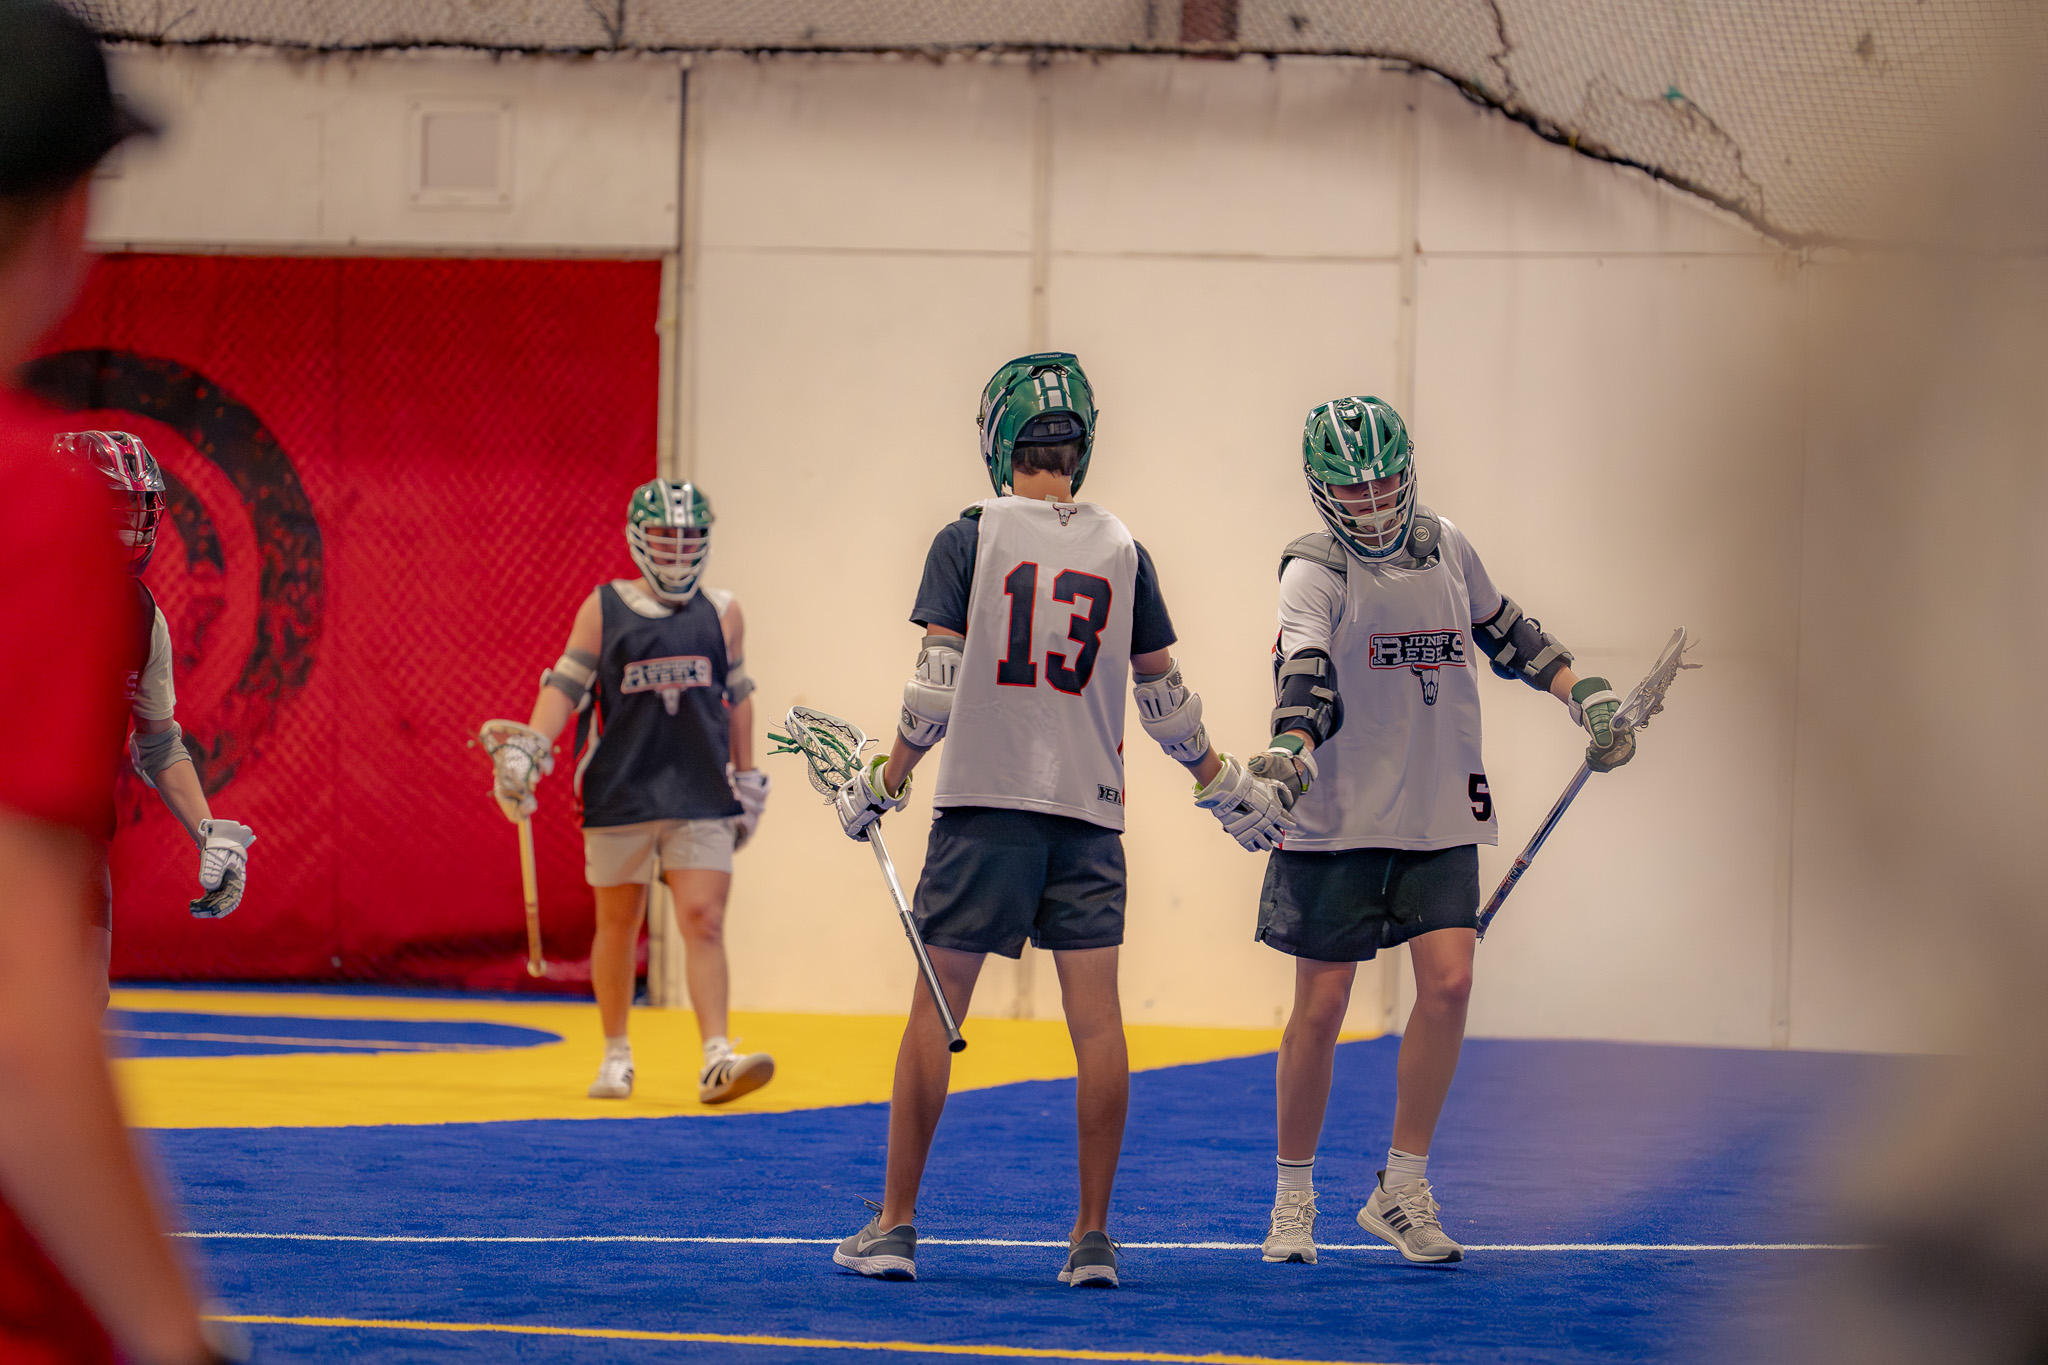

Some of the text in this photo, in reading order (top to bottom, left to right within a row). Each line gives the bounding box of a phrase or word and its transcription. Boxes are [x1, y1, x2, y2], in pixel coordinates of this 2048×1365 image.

[997, 561, 1112, 696] 13
[1405, 635, 1449, 647] JUNIR
[1097, 784, 1122, 806] YETI
[1468, 772, 1497, 822] 5
